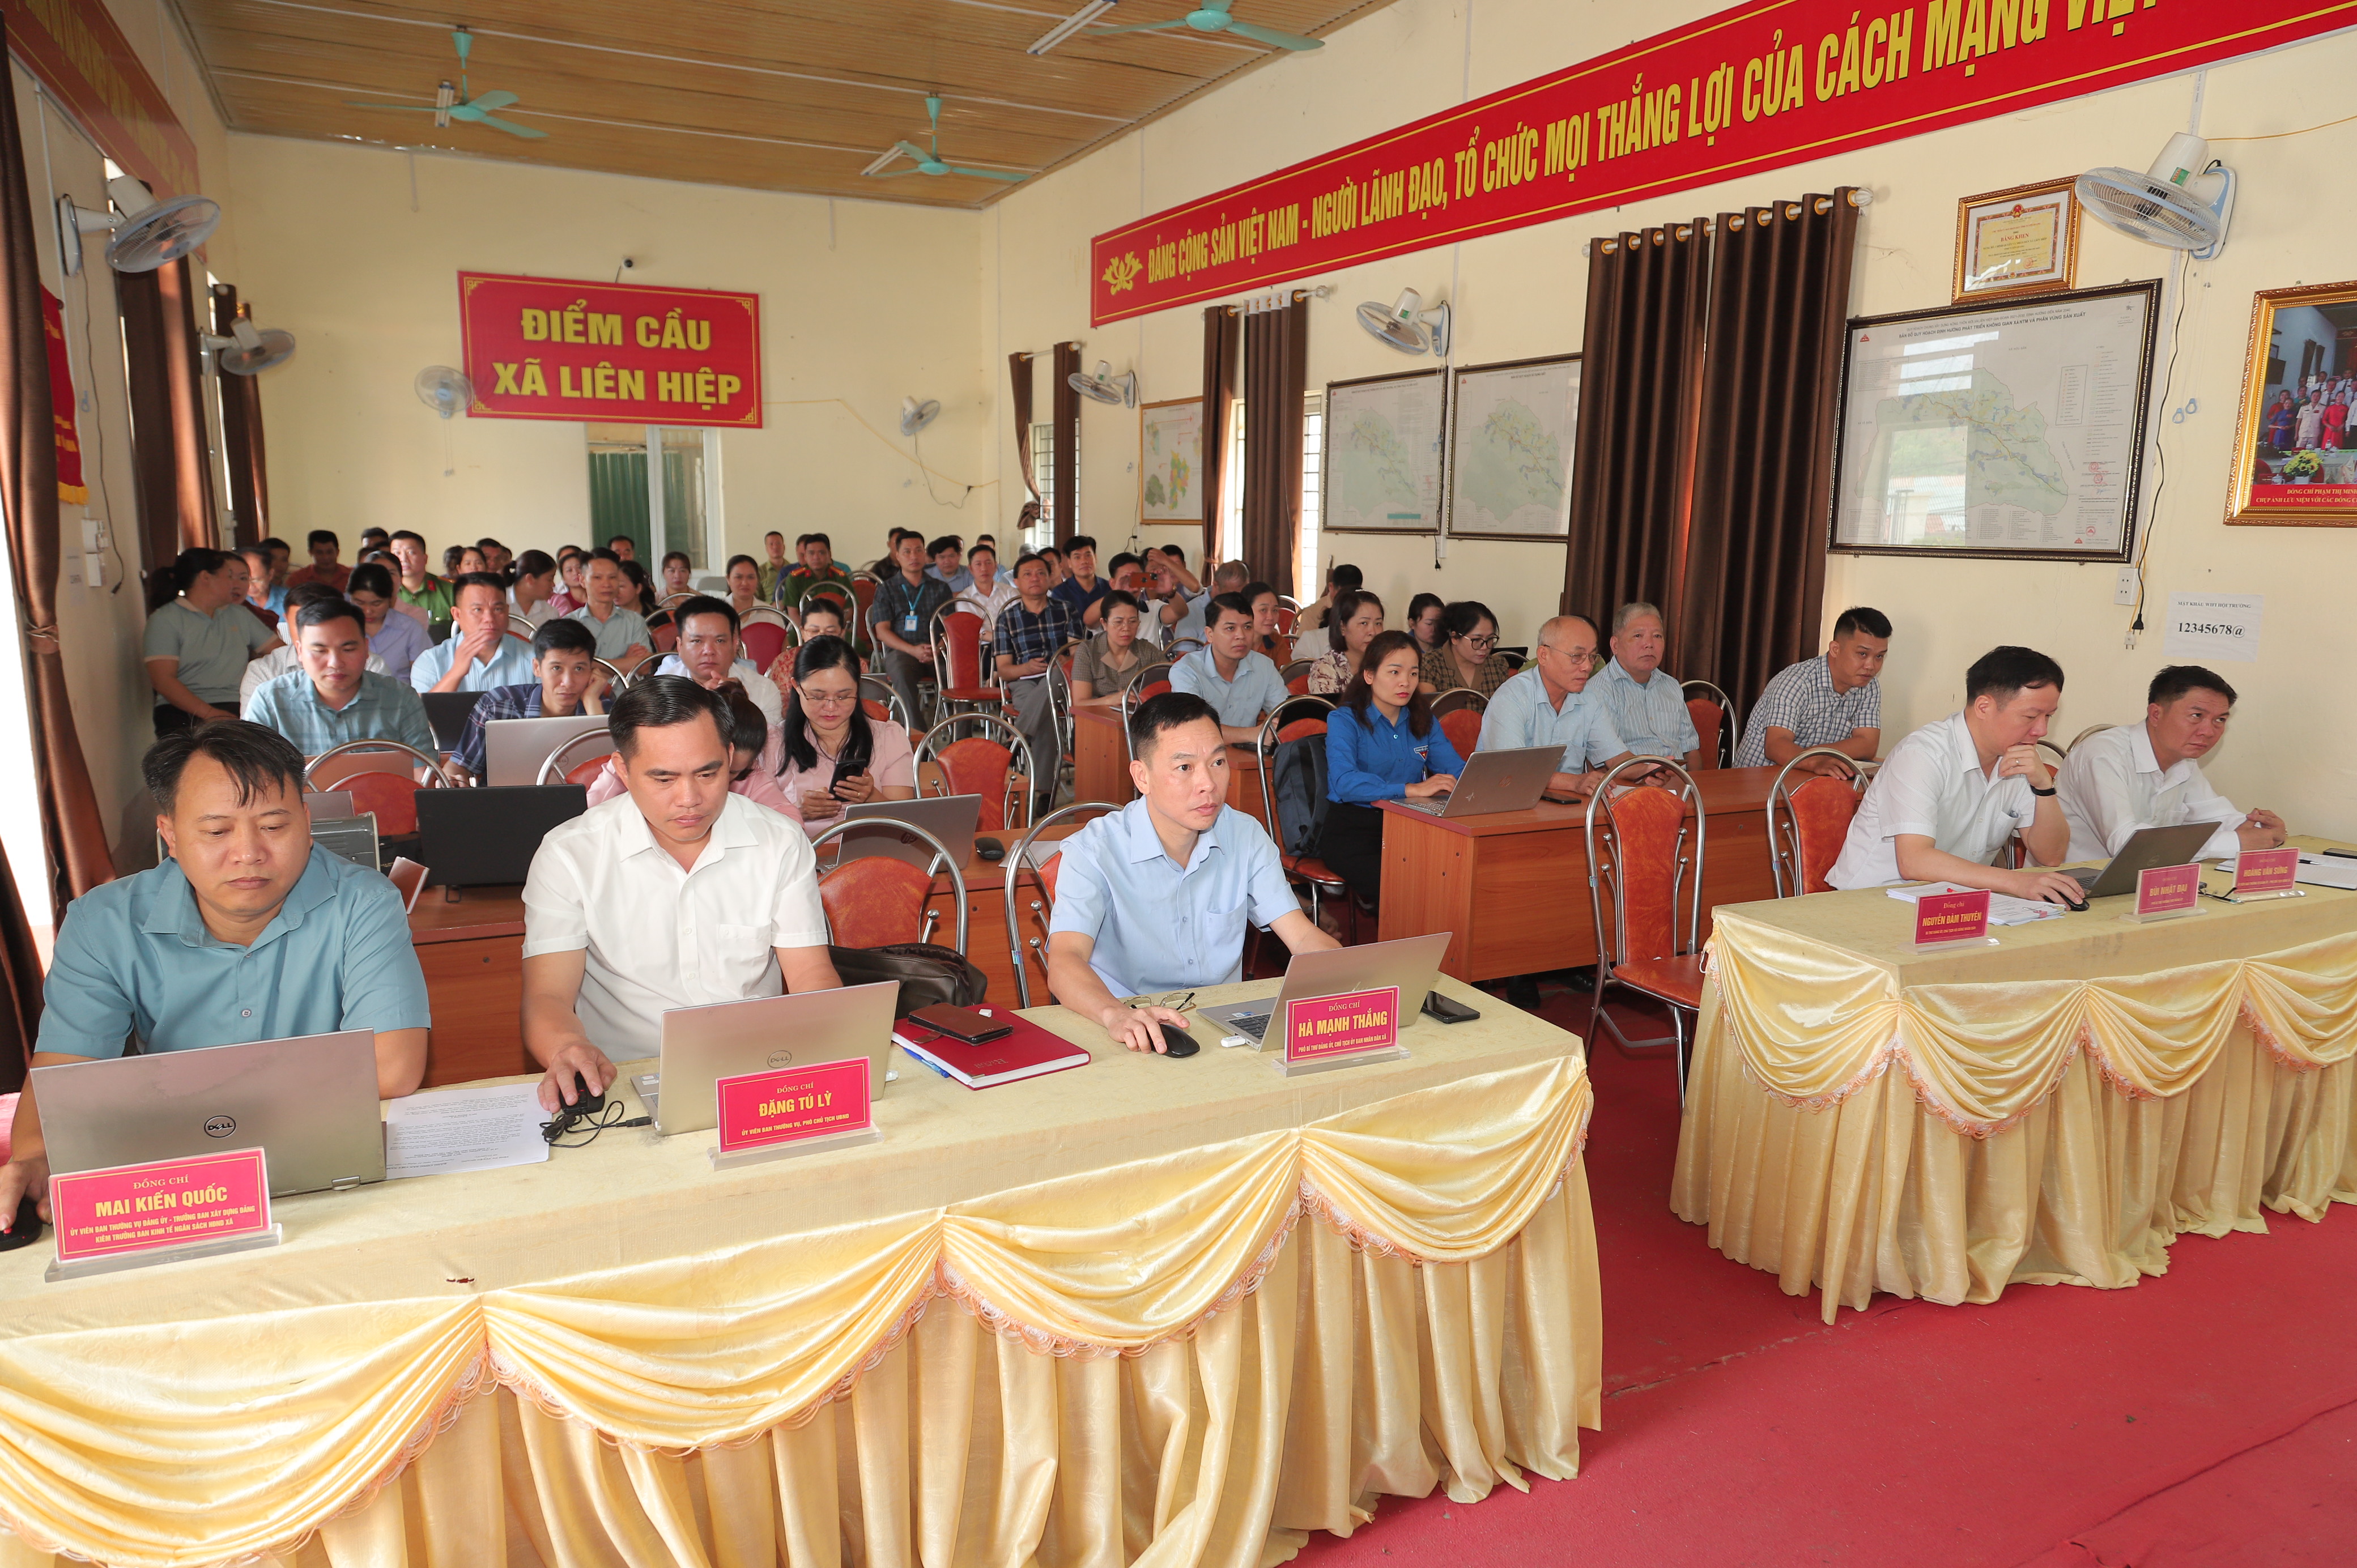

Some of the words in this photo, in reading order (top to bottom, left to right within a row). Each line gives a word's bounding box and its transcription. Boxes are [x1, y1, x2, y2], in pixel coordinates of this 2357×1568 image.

[1147, 234, 1176, 284] ĐẢNG
[1178, 229, 1207, 280] CỘNG
[1210, 213, 1236, 268] SẢN
[1238, 207, 1265, 264] VIỆT
[1267, 203, 1299, 250] NAM
[1311, 176, 1358, 240] NGƯỜI
[1360, 169, 1403, 227] LÃNH
[1407, 161, 1448, 220] ĐẠO,
[1454, 126, 1480, 201] TỔ
[1482, 126, 1539, 194] CHỨC
[1544, 112, 1590, 182] MỌI
[1597, 73, 1680, 163] THẮNG
[1687, 61, 1734, 146] LỢI
[1742, 28, 1805, 122] CỦA
[1815, 10, 1913, 103] CÁCH
[521, 299, 623, 346] ĐIỂM
[635, 307, 710, 351] CẦU
[492, 358, 547, 397] XÃ
[559, 361, 645, 401] LIÊN
[657, 367, 741, 411] HIỆP
[2178, 622, 2245, 638] 12345678@
[1922, 913, 1946, 927] NGUYỄN
[1328, 1003, 1347, 1012] ĐỒNG
[1348, 1000, 1360, 1009] CHÍ
[1298, 1019, 1313, 1038] HÀ
[1316, 1016, 1350, 1037] MẠNH
[1352, 1007, 1388, 1030] THẮNG
[777, 1084, 798, 1094] ĐỒNG
[800, 1081, 814, 1090] CHÍ
[759, 1099, 795, 1118] ĐẶNG
[798, 1093, 814, 1110] TÚ
[817, 1090, 832, 1107] LỲ
[749, 1126, 761, 1135] VIÊN
[773, 1122, 793, 1131] THƯỜNG
[813, 1117, 823, 1125] CHỦ
[133, 1178, 165, 1190] ĐỒNG
[169, 1174, 189, 1185] CHÍ
[95, 1198, 130, 1218] MAI
[135, 1190, 177, 1213] KIẾN
[182, 1183, 228, 1208] QUỐC
[70, 1227, 78, 1237] ỦY
[79, 1225, 93, 1235] VIÊN
[109, 1220, 133, 1232] THƯỜNG
[133, 1220, 142, 1230] VỤ
[142, 1217, 159, 1226] ĐẢNG
[160, 1215, 168, 1224] ỦY
[173, 1212, 196, 1223] TRƯỞNG
[197, 1212, 210, 1221] BAN
[210, 1209, 222, 1218] XÂY
[223, 1208, 239, 1218] DỰNG
[239, 1205, 256, 1215] ĐẢNG
[95, 1233, 111, 1243] KIÊM
[112, 1230, 136, 1241] TRƯỞNG
[137, 1230, 150, 1238] BAN
[151, 1228, 165, 1237] KINH
[165, 1224, 173, 1235] TẾ
[174, 1224, 191, 1233] NGÂN
[192, 1221, 207, 1231] SÁCH
[208, 1219, 224, 1229] HĐND
[225, 1217, 234, 1226] XÃ
